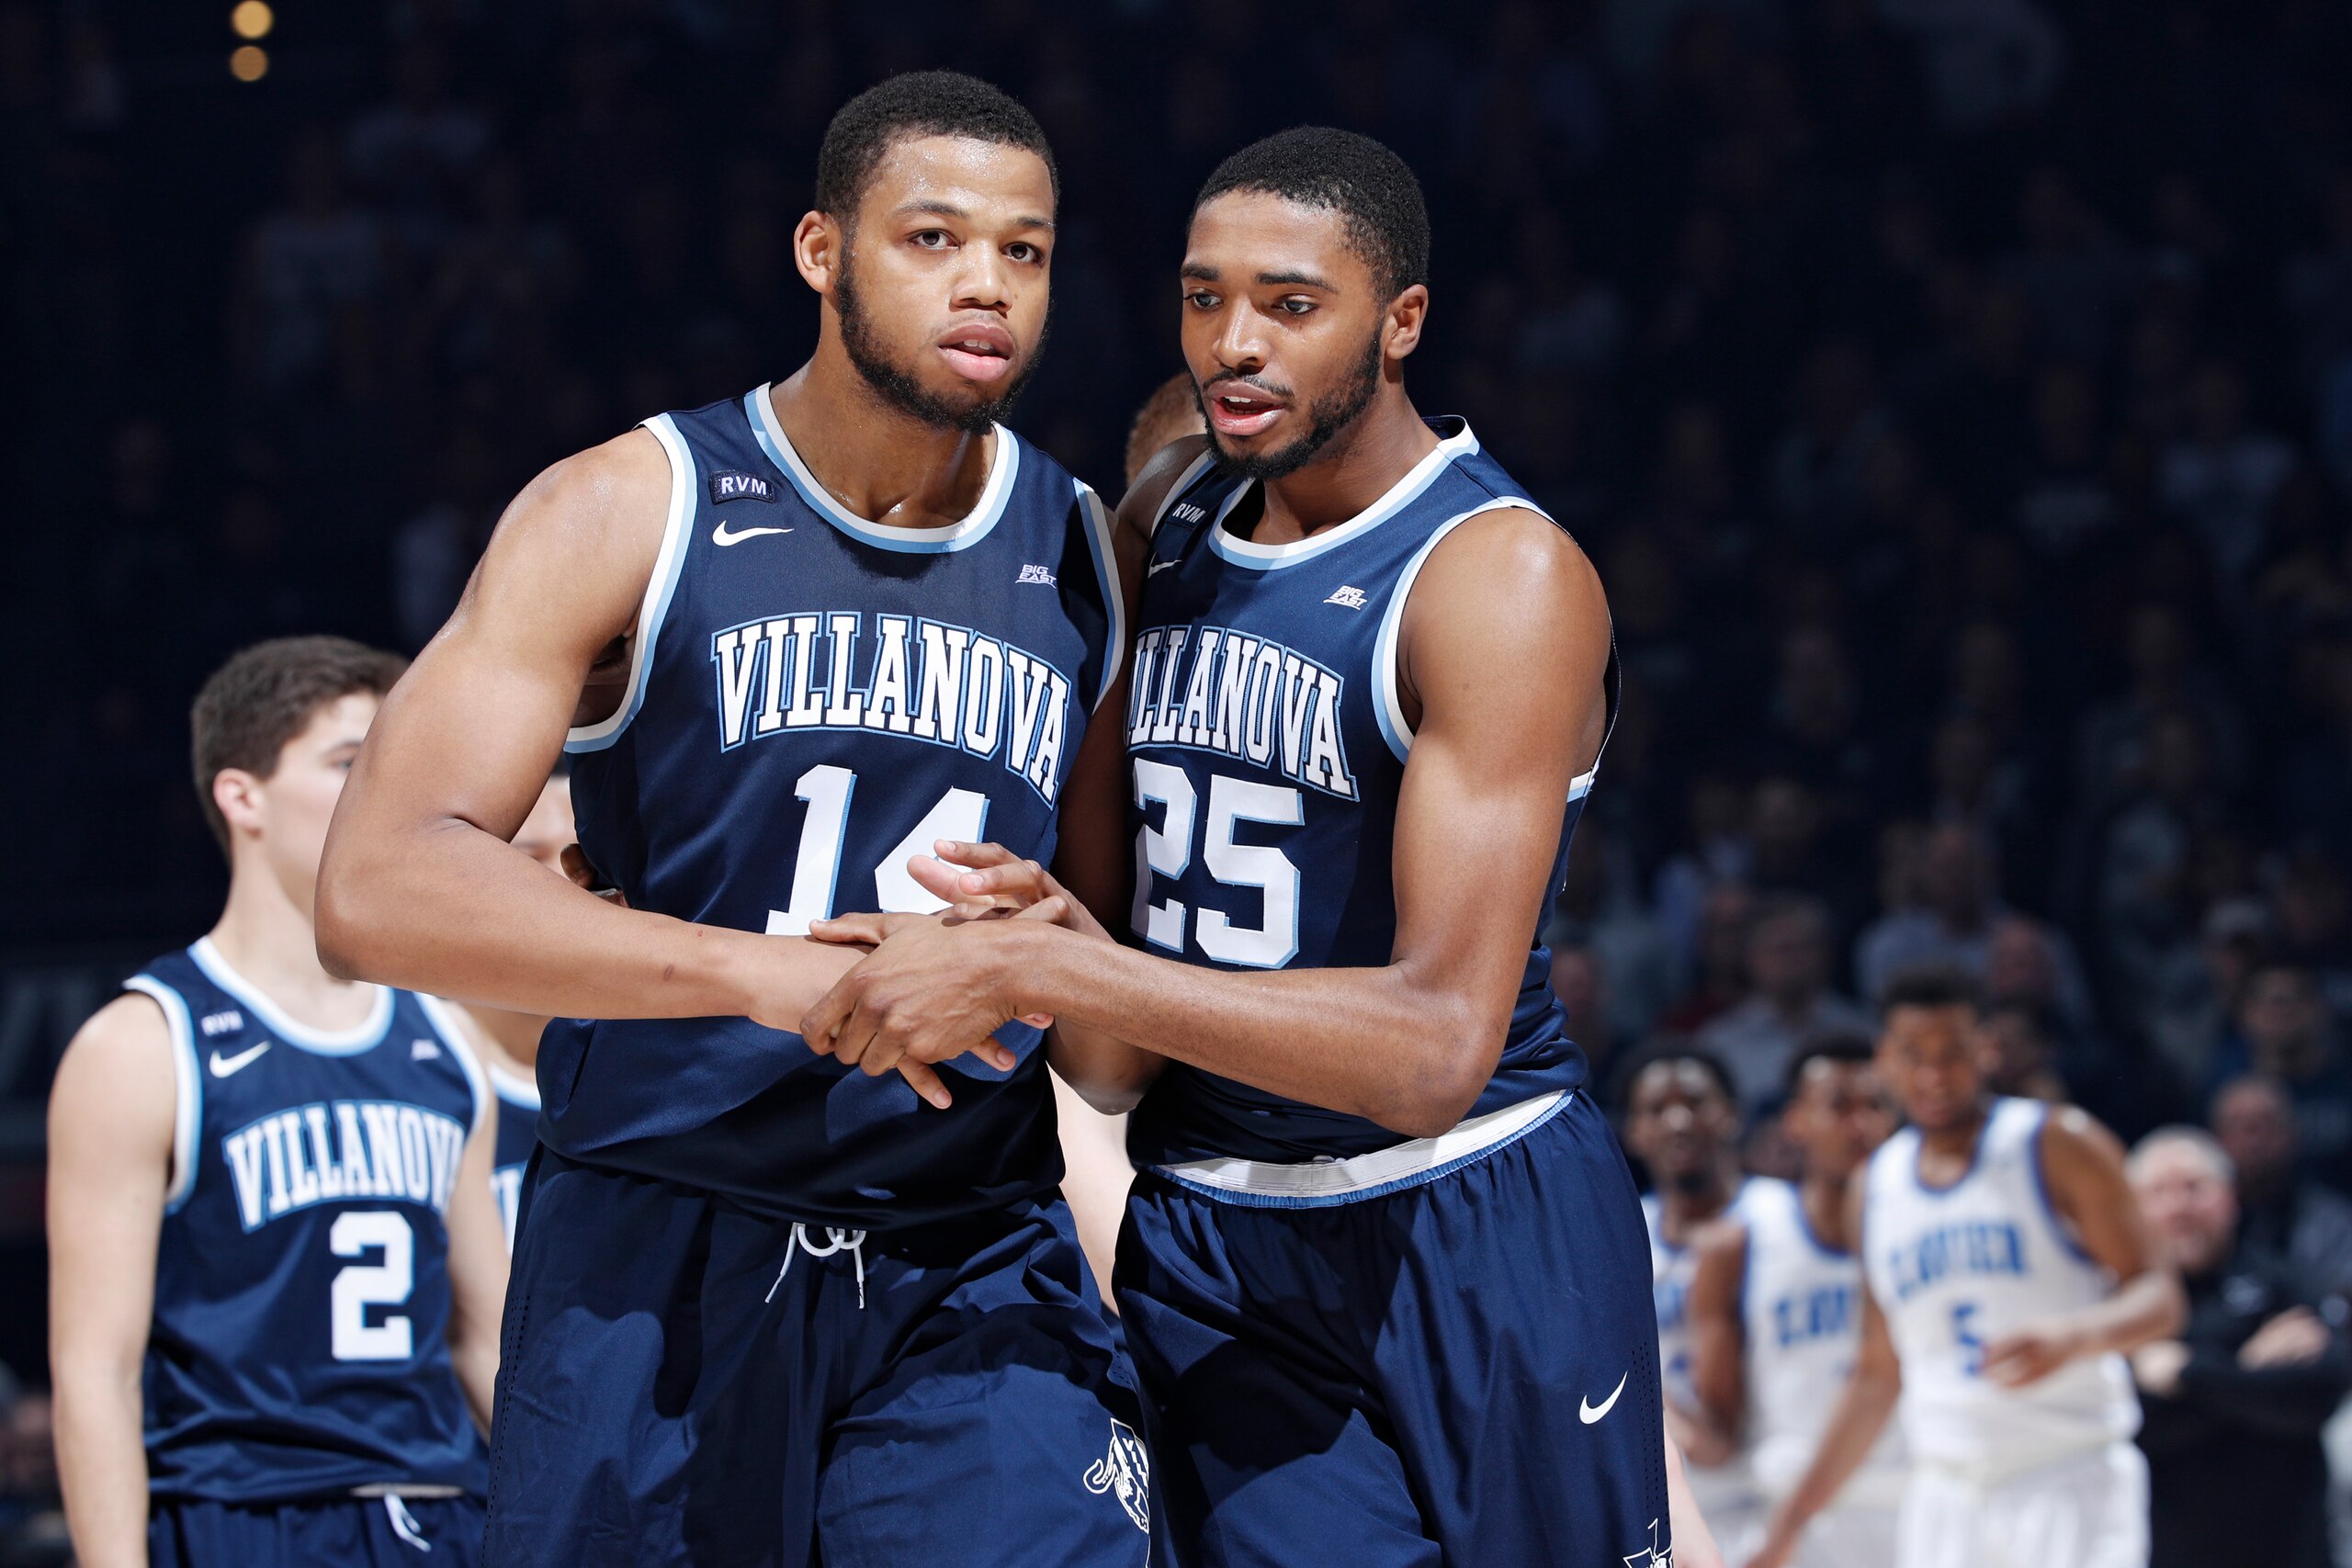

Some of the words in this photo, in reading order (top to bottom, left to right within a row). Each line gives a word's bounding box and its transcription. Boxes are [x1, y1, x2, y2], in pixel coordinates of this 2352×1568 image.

[720, 476, 767, 496] RVM
[1171, 502, 1206, 524] RVM
[1018, 572, 1057, 584] EAST
[1022, 563, 1049, 575] BIG
[1329, 592, 1367, 606] EAST
[1337, 586, 1365, 598] BIG
[710, 611, 1072, 812] VILLANOVA
[1126, 625, 1361, 802] ILLANOVA
[1130, 757, 1305, 970] 25
[329, 1210, 413, 1360] 2
